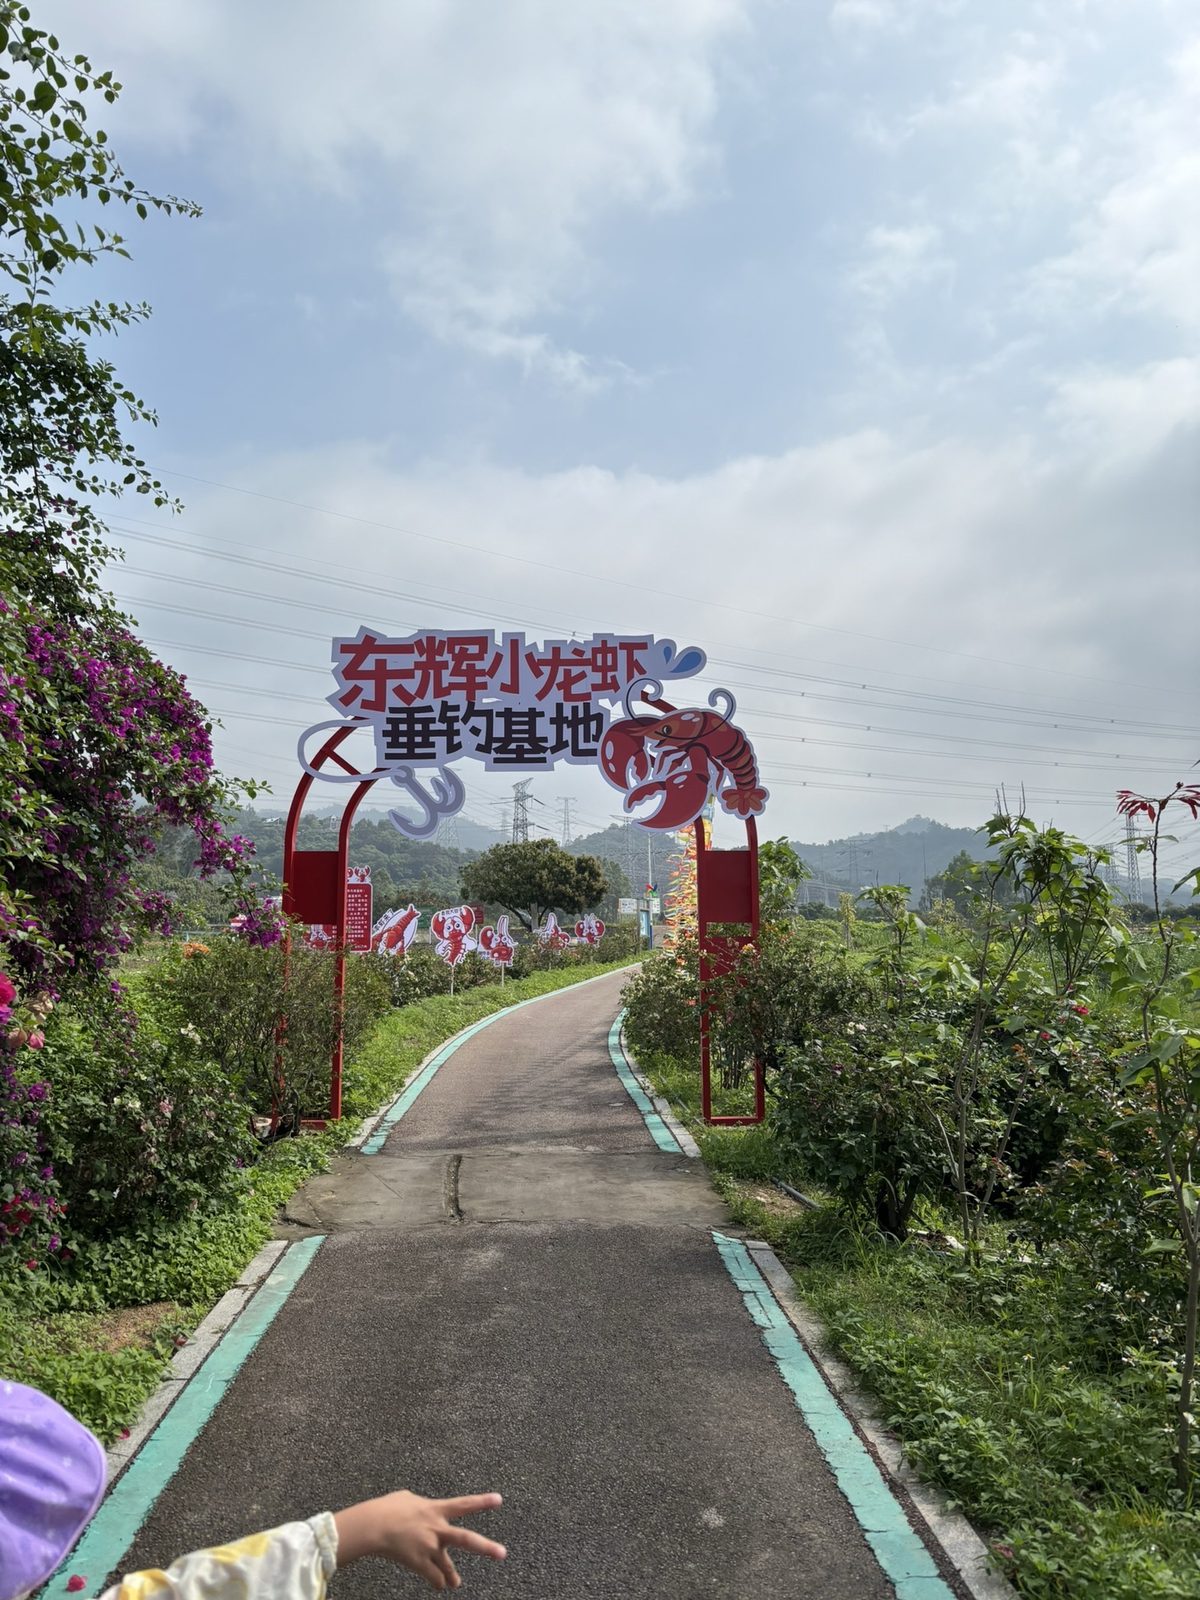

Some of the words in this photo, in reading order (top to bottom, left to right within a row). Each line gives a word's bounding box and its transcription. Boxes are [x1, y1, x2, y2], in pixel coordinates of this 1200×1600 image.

[339, 635, 649, 712] 东辉小龙虾
[382, 701, 603, 764] 垂钓基地
